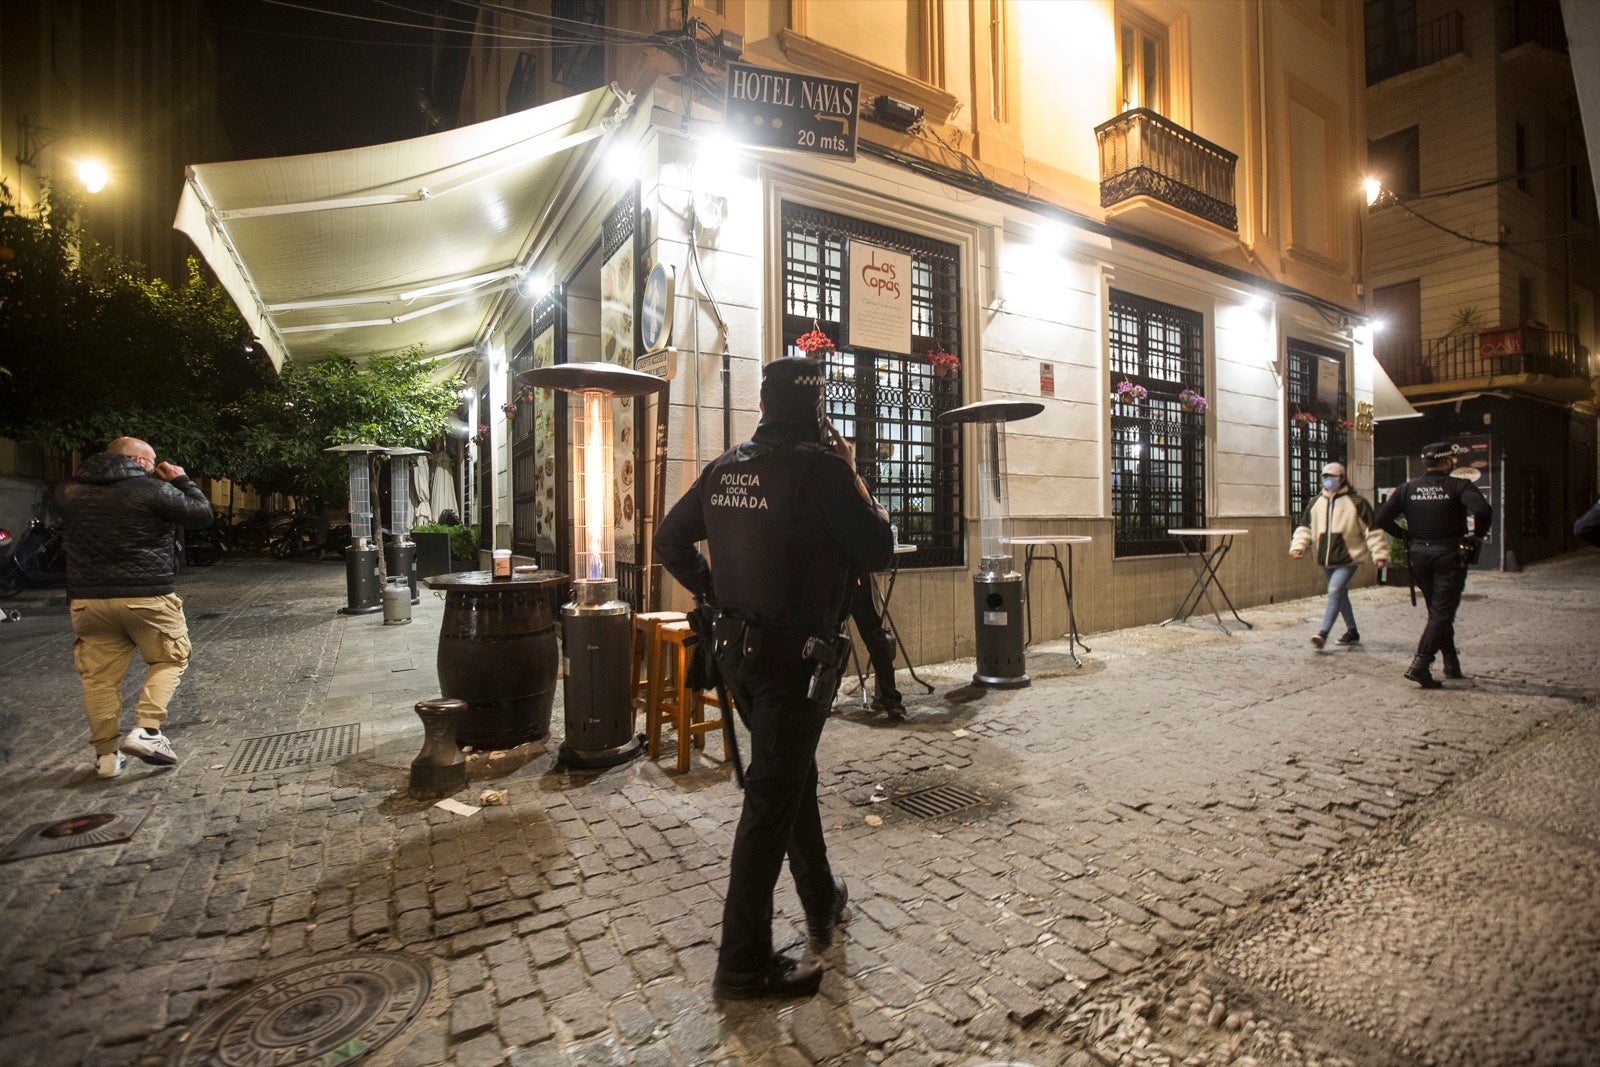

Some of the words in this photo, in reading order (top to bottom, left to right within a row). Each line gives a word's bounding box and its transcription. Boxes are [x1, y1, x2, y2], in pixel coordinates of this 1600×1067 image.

[732, 70, 794, 107] HOTEL
[800, 80, 853, 116] NAVAS
[797, 129, 816, 147] 20
[820, 135, 849, 152] mts.
[863, 250, 896, 280] Las
[861, 264, 901, 300] Copas
[720, 473, 760, 487] POLICIA
[726, 486, 748, 496] LOCAL
[1410, 493, 1450, 501] GRANADA
[710, 493, 768, 510] GRANADA
